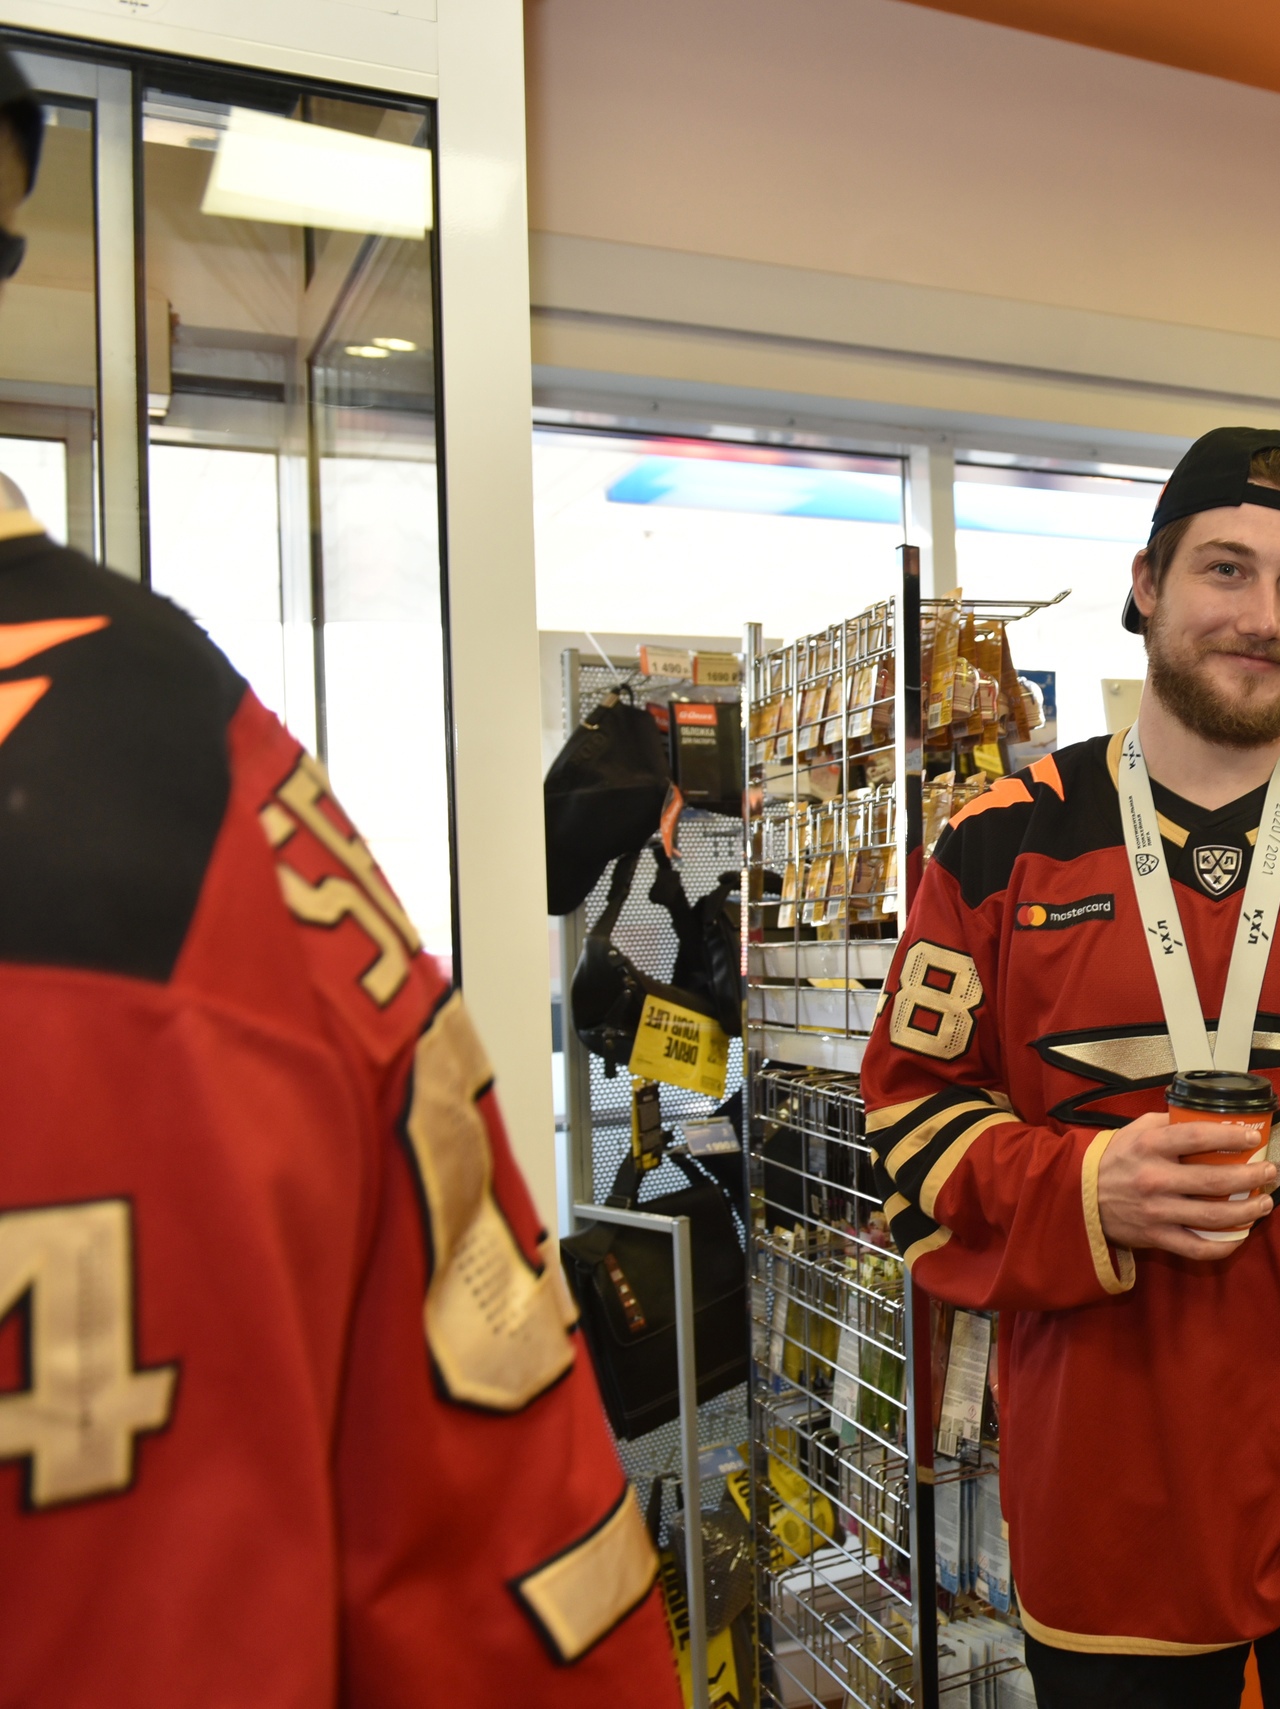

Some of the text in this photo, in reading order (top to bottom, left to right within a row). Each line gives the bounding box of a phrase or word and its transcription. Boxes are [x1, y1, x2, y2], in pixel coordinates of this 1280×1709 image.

[1050, 900, 1111, 921] mastercard
[1246, 908, 1267, 945] КХЛ
[1153, 919, 1179, 955] КХЛ
[663, 1036, 699, 1066] DRIVE
